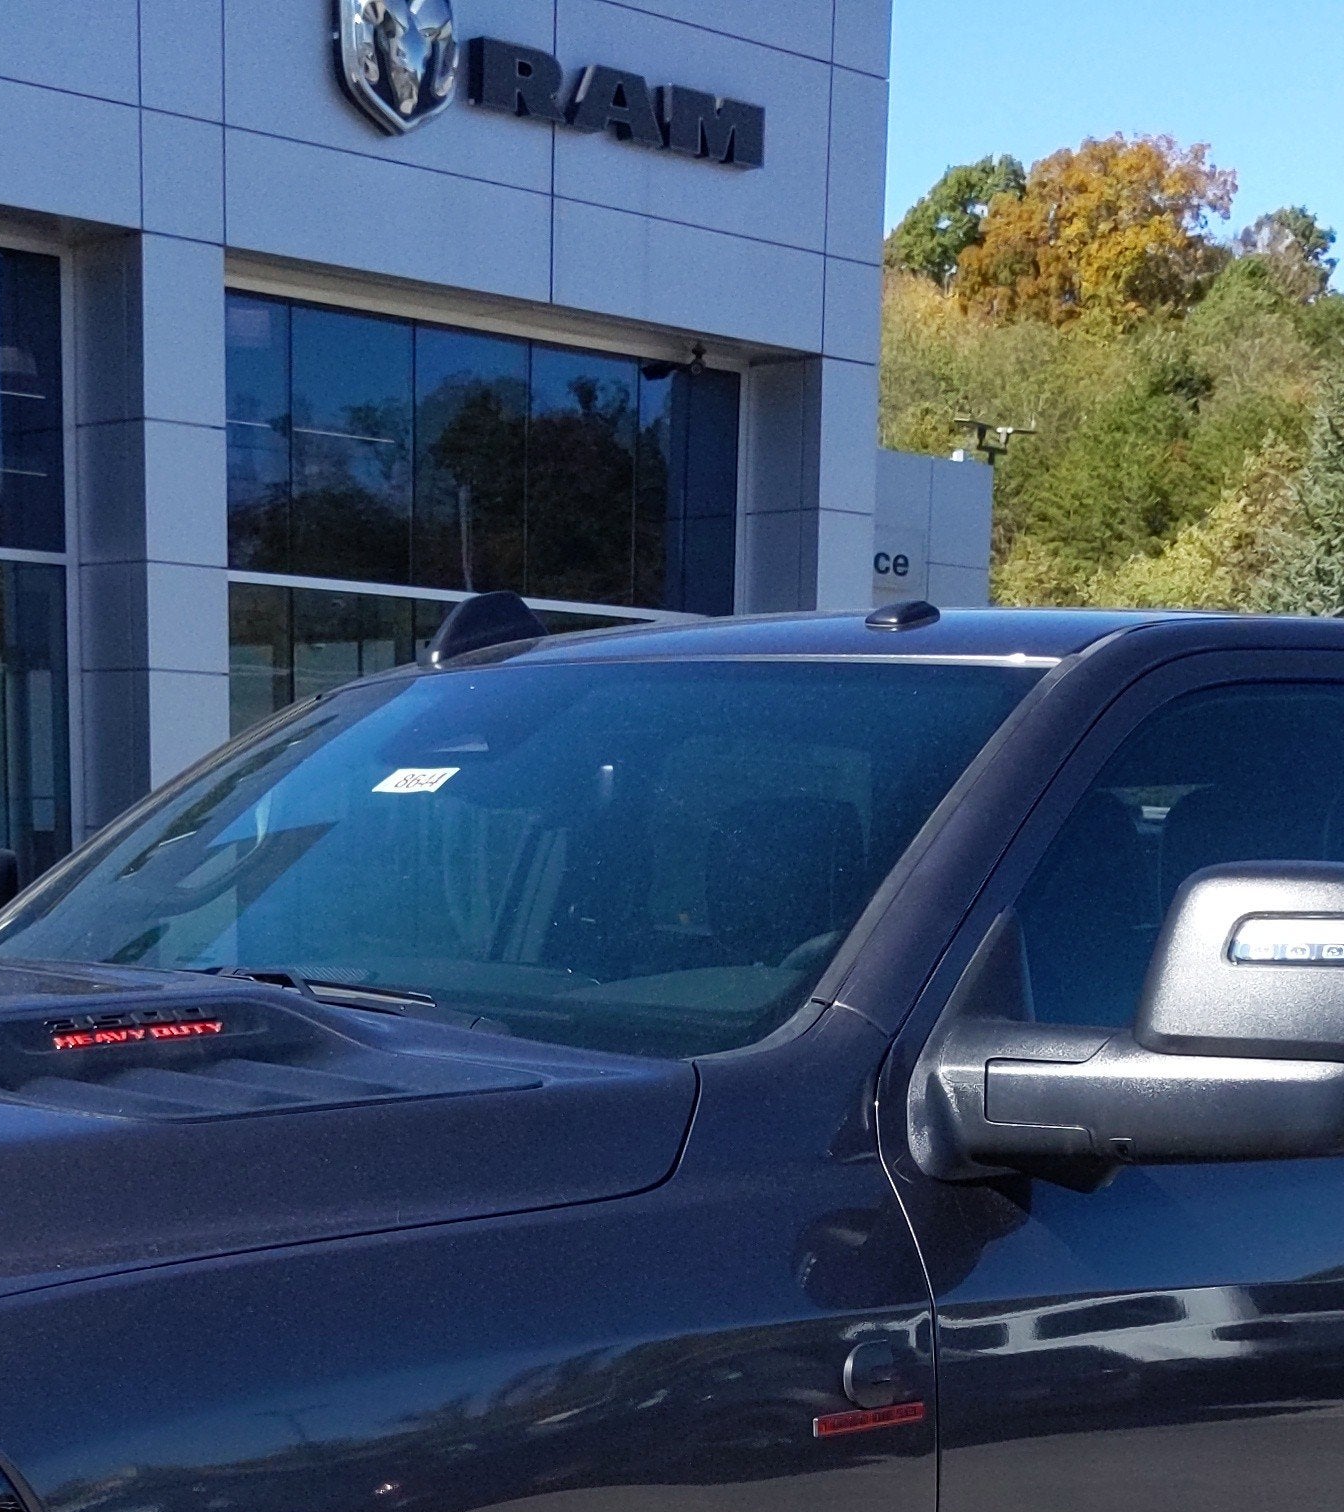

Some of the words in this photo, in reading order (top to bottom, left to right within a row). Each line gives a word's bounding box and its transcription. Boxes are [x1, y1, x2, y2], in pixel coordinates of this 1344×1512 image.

[467, 35, 765, 169] RAM
[53, 1028, 147, 1050] HEAVY
[151, 1021, 224, 1039] DUTY
